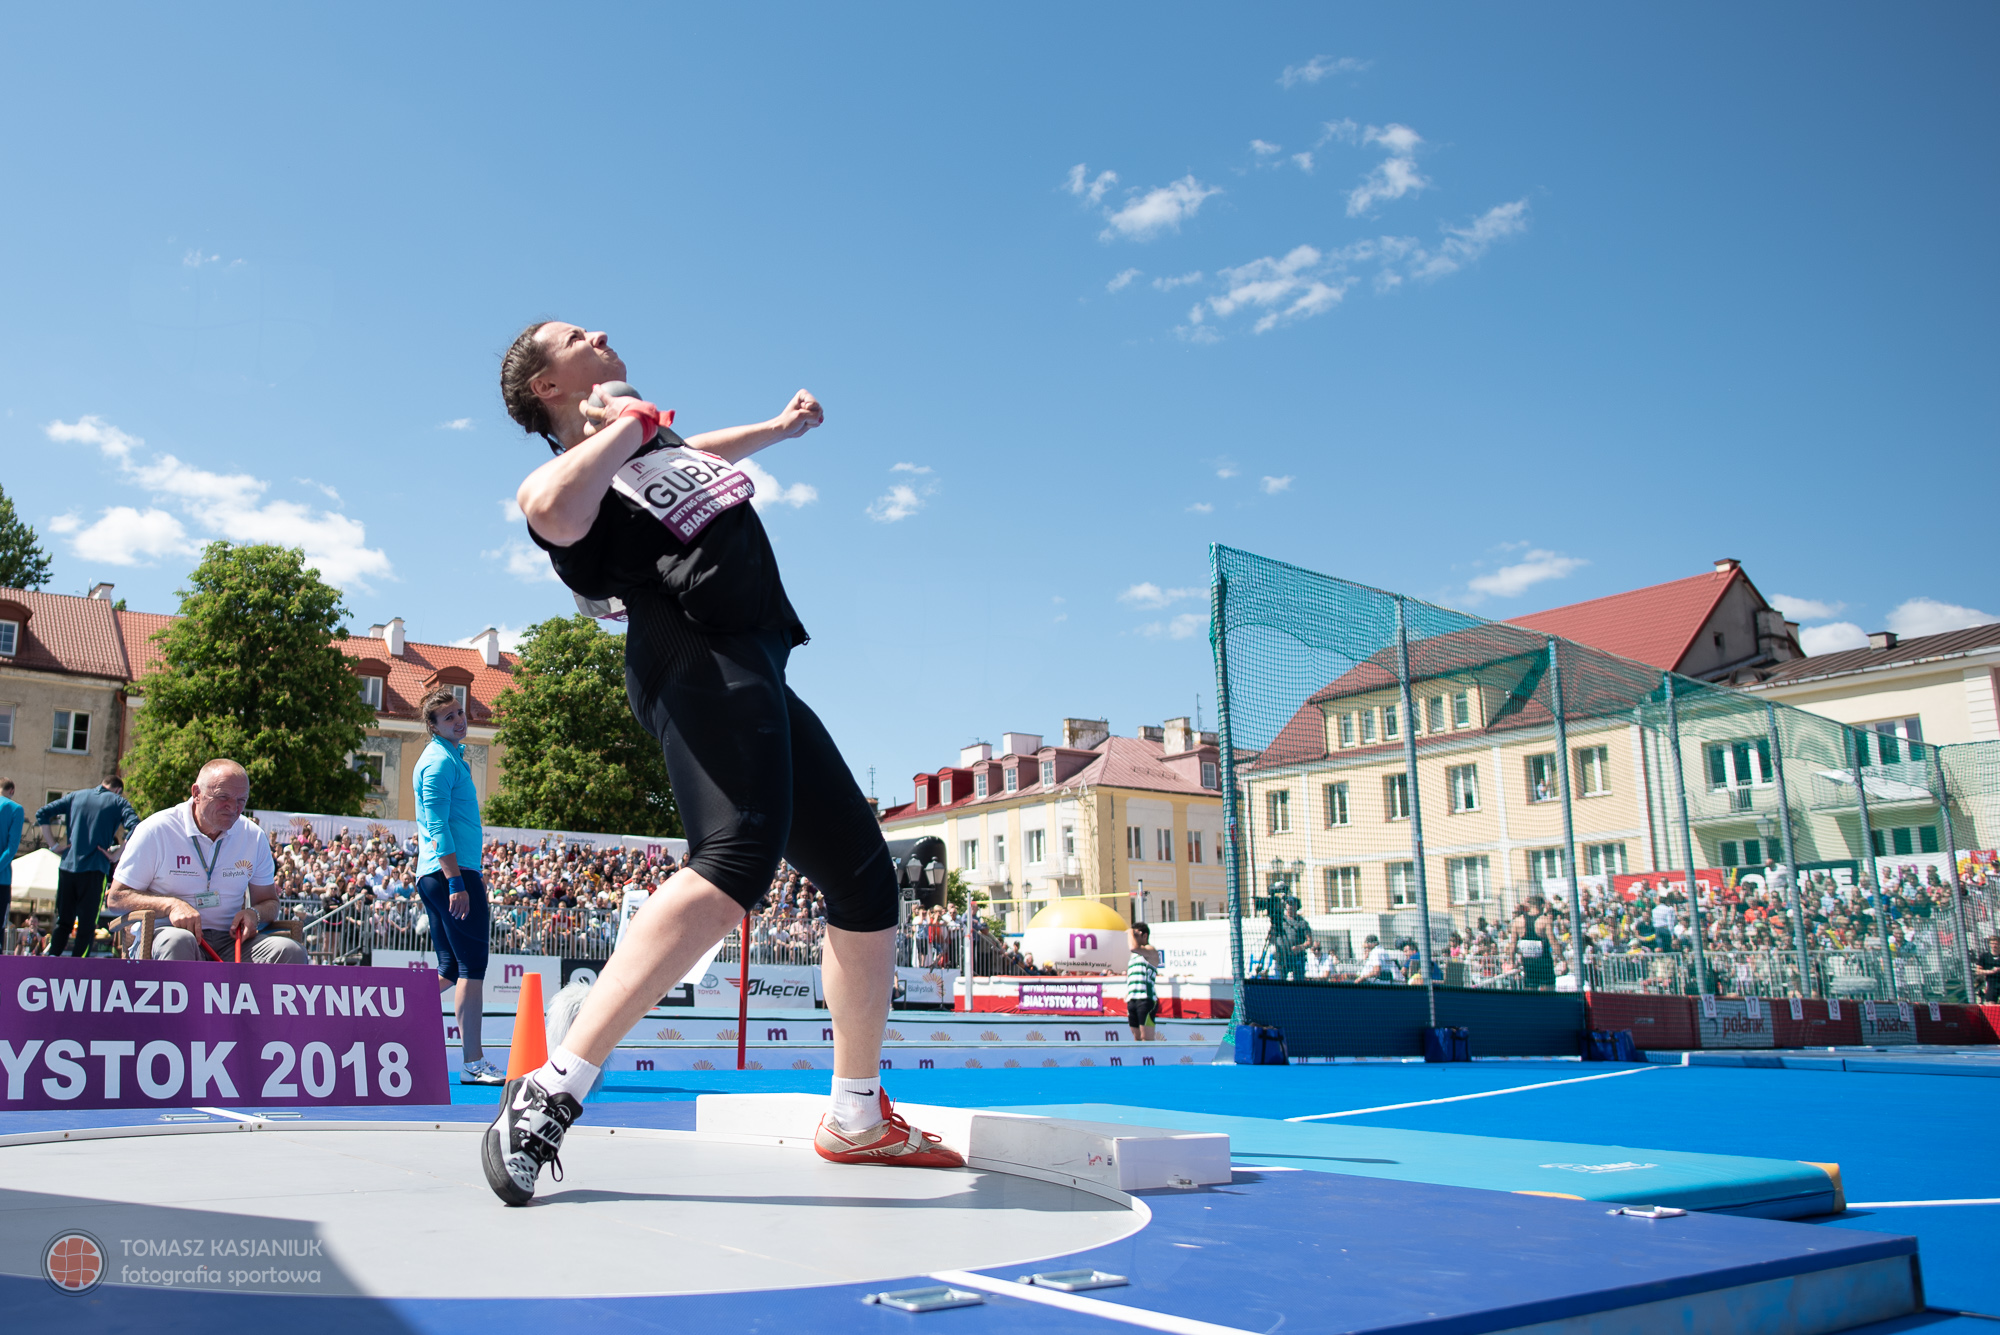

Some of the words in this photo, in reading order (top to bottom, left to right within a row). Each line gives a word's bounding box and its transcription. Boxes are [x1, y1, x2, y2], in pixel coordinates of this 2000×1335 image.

[644, 460, 732, 509] GUBA
[670, 499, 697, 524] MITYNG
[695, 488, 718, 502] GWIAZD
[680, 492, 738, 537] BIAŁYSTOK
[732, 482, 755, 498] 2018
[17, 977, 189, 1014] GWIAZD
[204, 982, 260, 1015] NA
[272, 984, 405, 1018] RYNKU
[1023, 995, 1074, 1008] BIAŁYSTOK
[1075, 996, 1099, 1009] 2018
[1704, 994, 1714, 1011] 16
[1748, 996, 1757, 1013] 17
[1792, 998, 1801, 1013] 18
[1829, 999, 1839, 1014] 19
[1865, 1001, 1874, 1015] 20
[1900, 1002, 1907, 1016] 21
[0, 1039, 240, 1101] YSTOK
[260, 1041, 413, 1098] 2018
